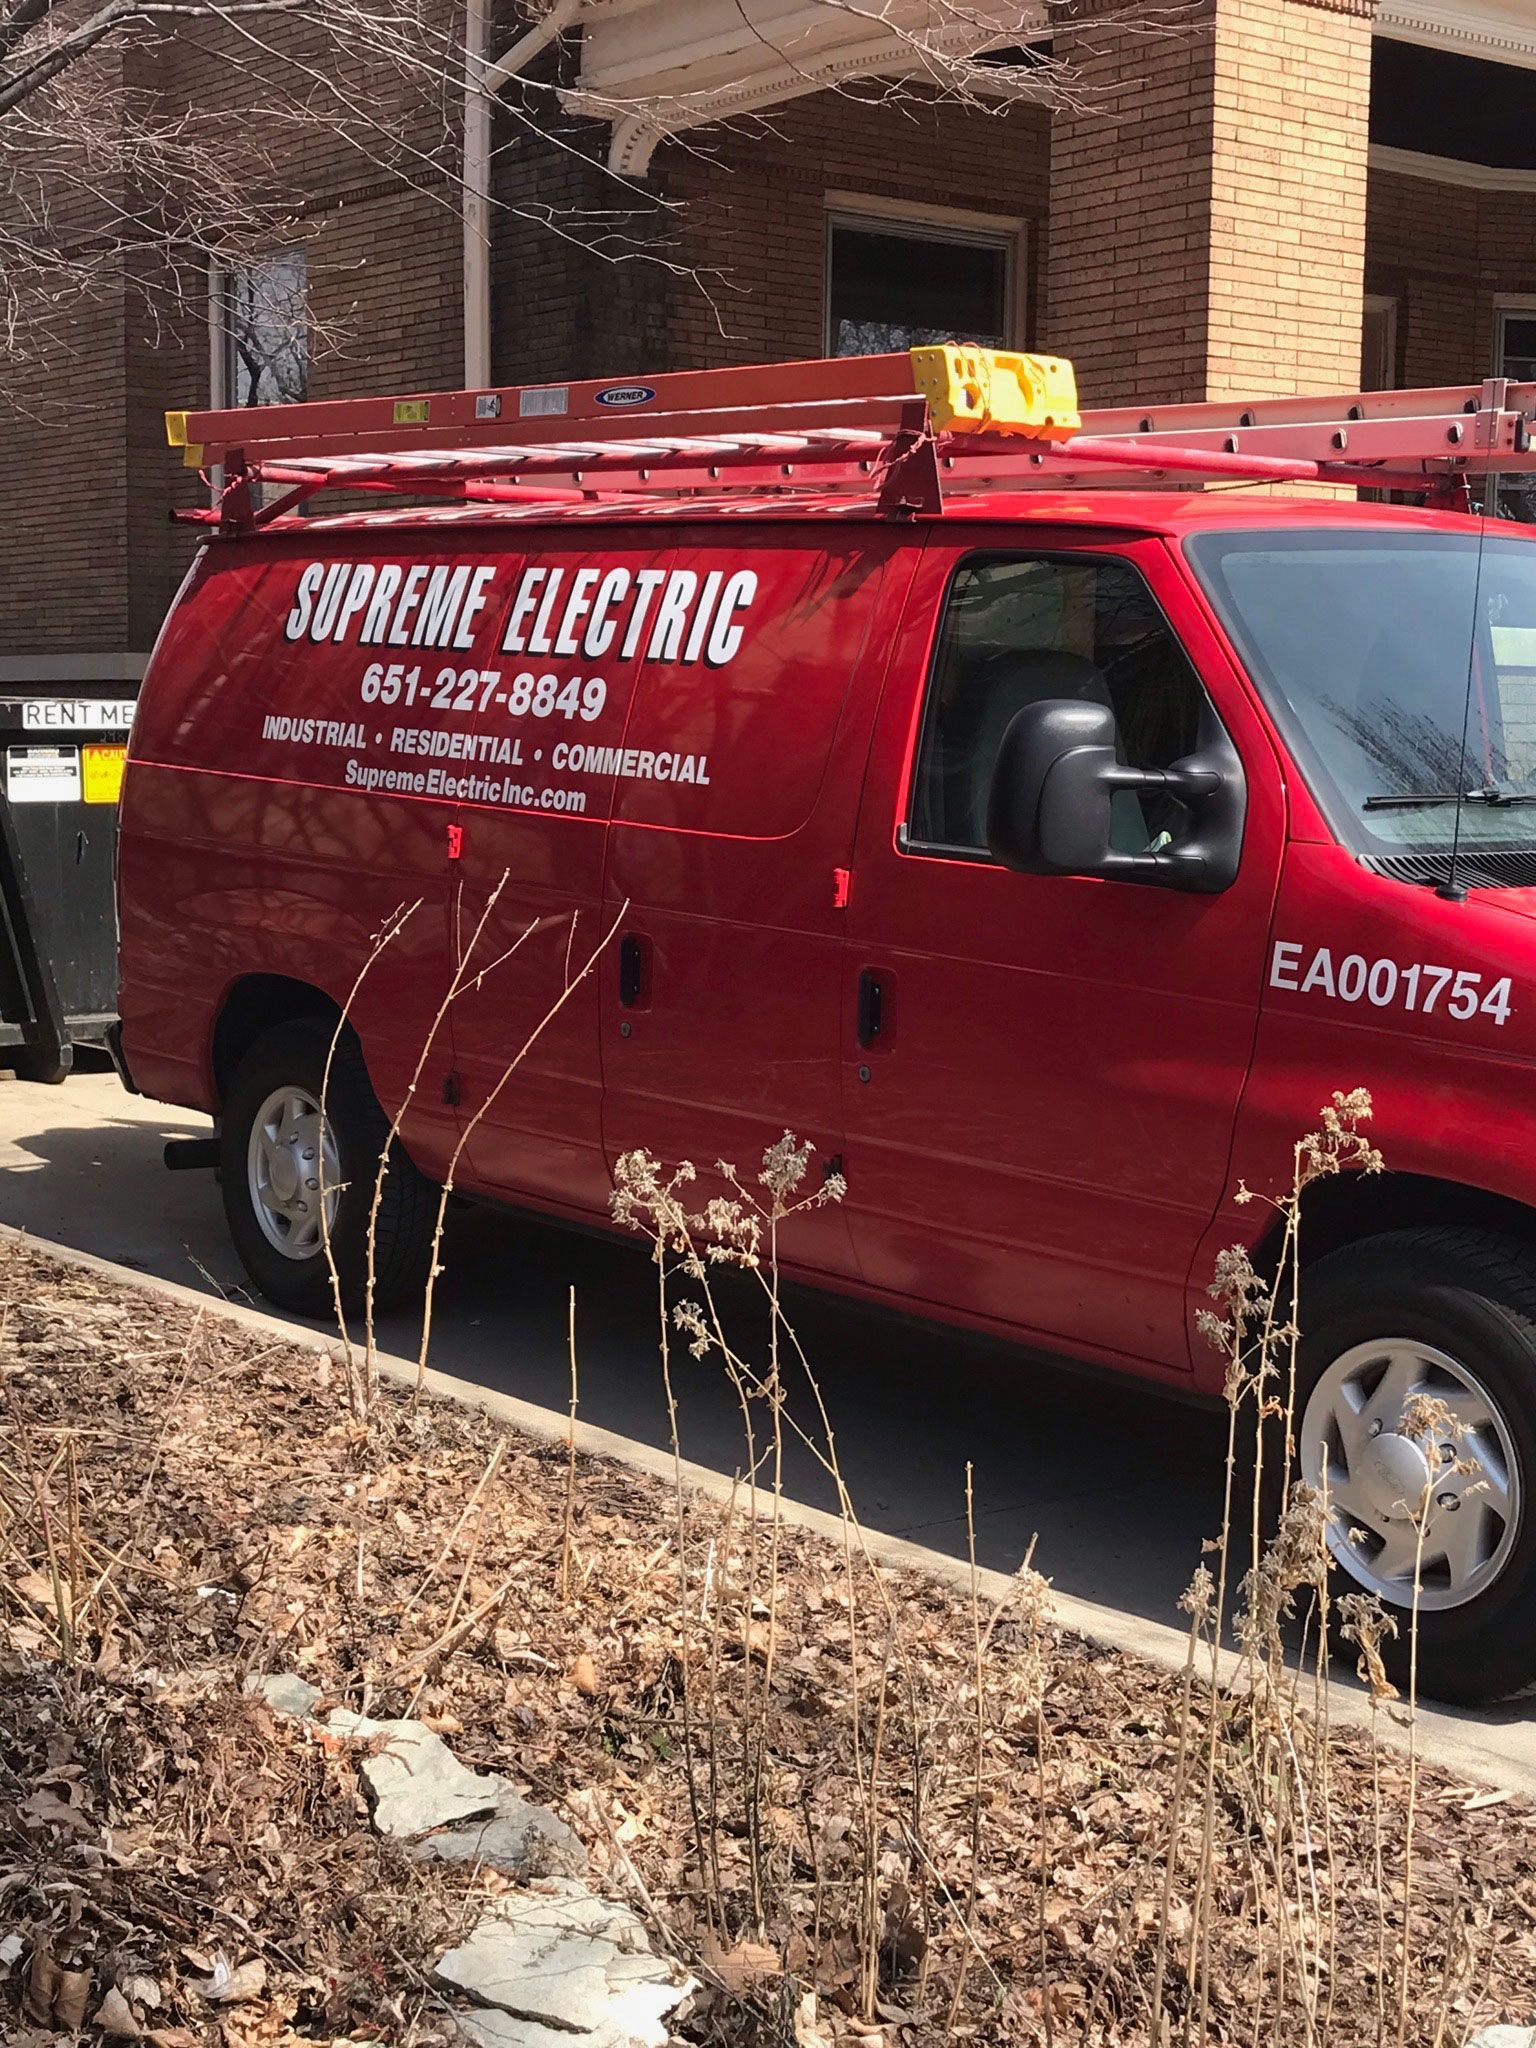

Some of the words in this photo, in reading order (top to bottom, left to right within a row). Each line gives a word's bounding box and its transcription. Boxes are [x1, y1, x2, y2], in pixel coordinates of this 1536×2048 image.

[607, 391, 643, 401] WERNER
[285, 562, 497, 649] SUPREME
[500, 567, 758, 669] ELECTRIC
[27, 705, 91, 724] RENT
[101, 705, 134, 724] ME
[361, 663, 607, 722] 651-227-8849
[262, 715, 367, 749] INDUSTRIAL
[390, 728, 523, 765] RESIDENTIAL
[552, 742, 710, 785] COMMERCIAL
[345, 759, 586, 812] SupremeElectricInc.com
[1270, 941, 1512, 1025] EA001754
